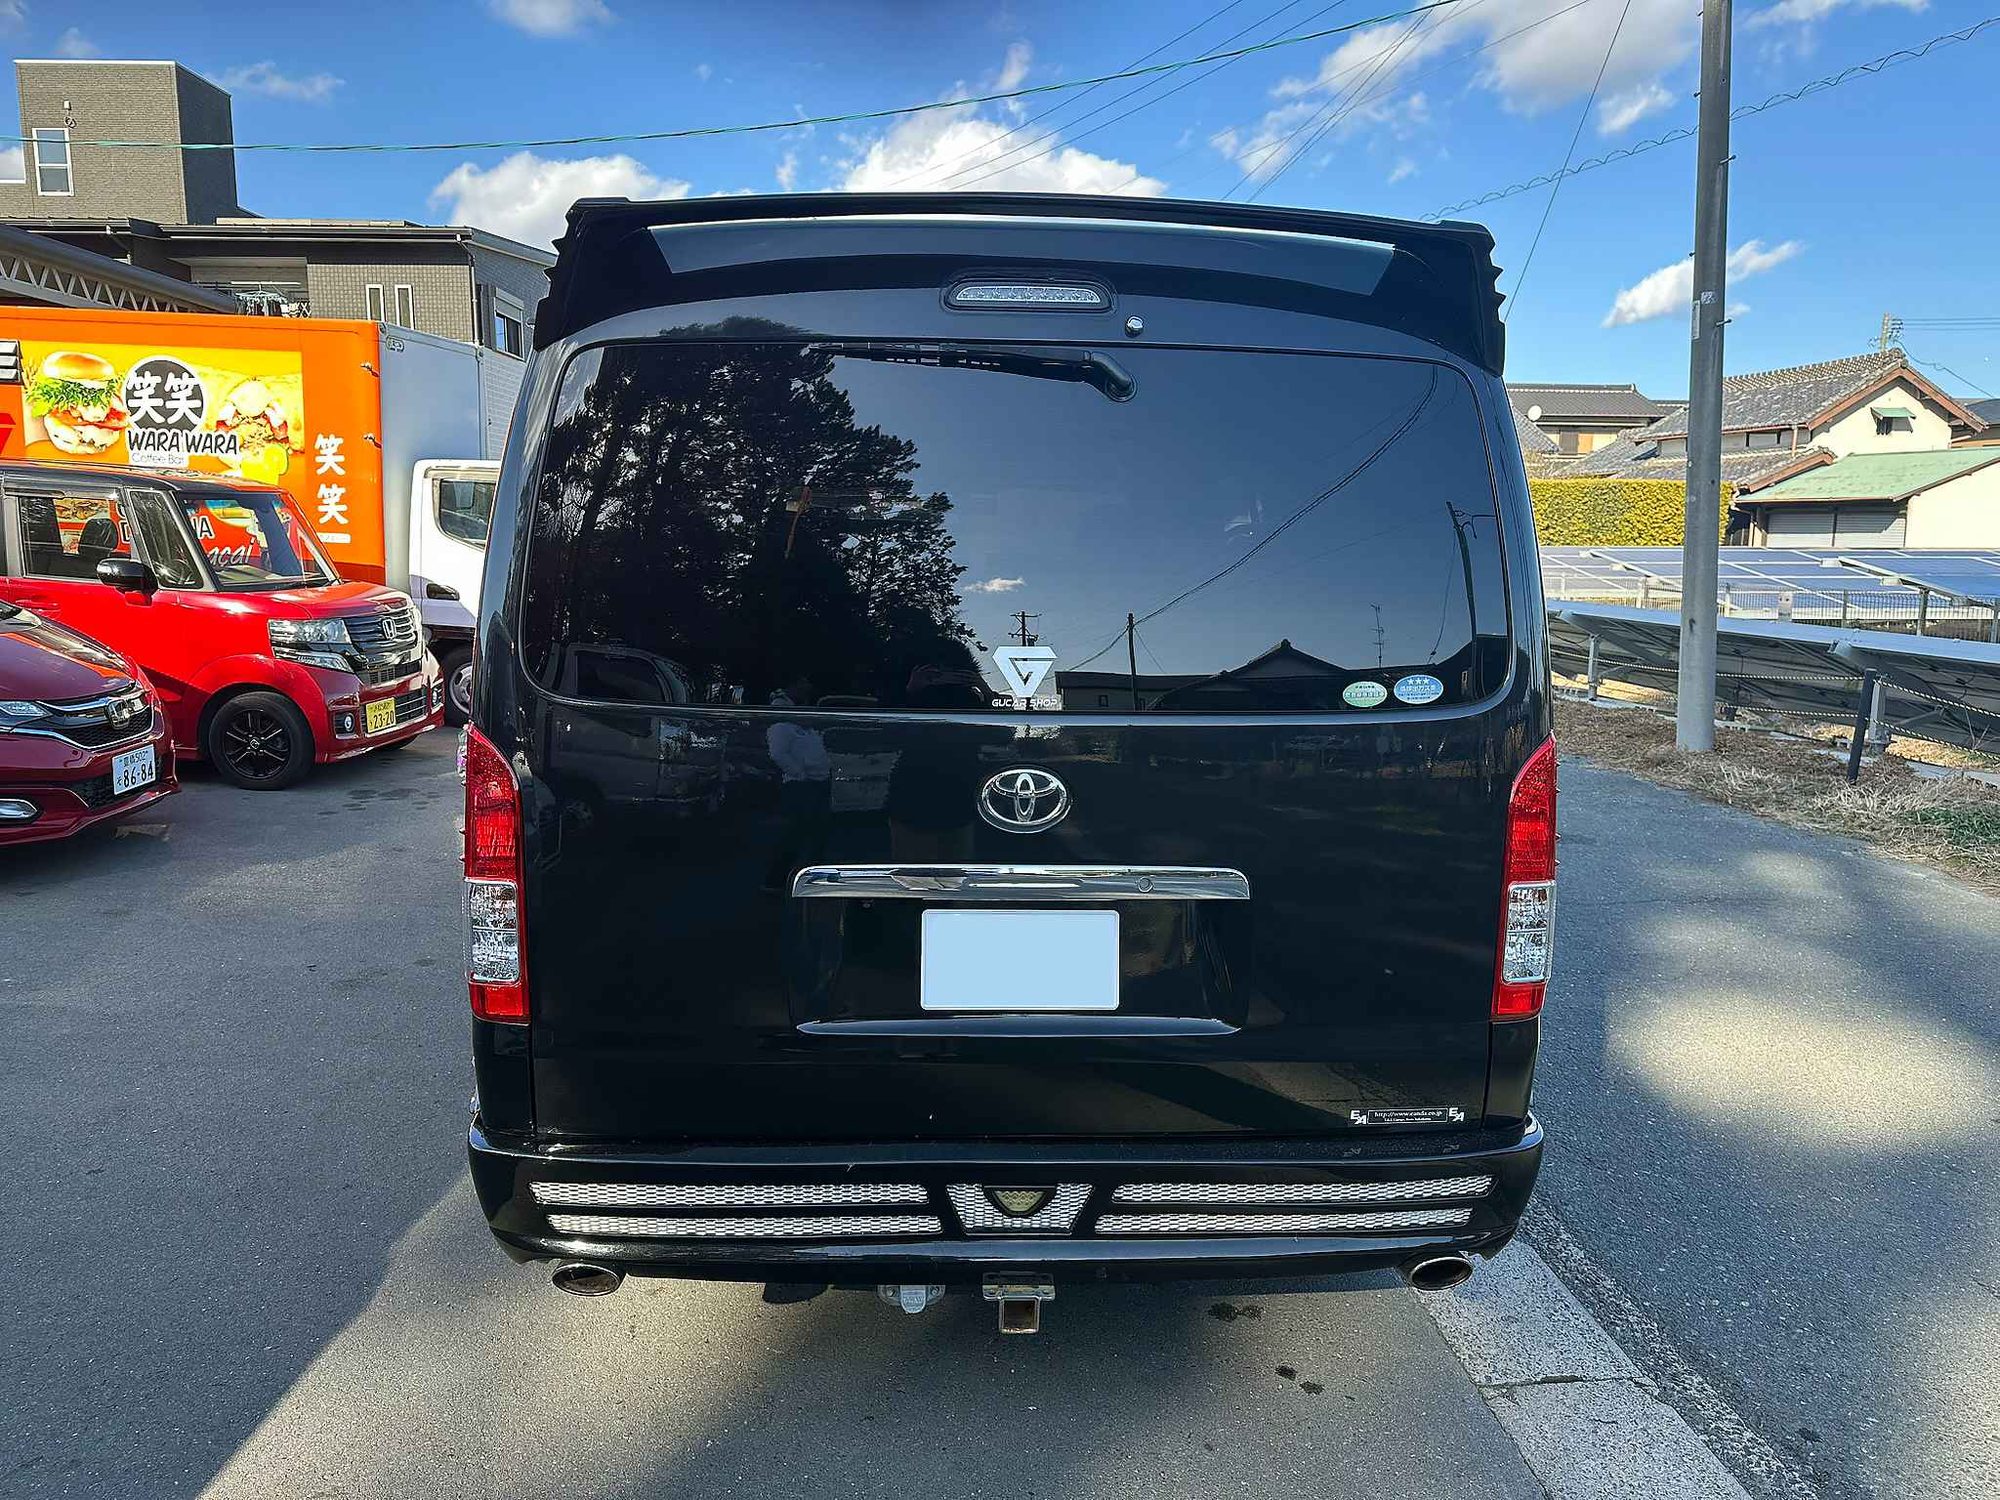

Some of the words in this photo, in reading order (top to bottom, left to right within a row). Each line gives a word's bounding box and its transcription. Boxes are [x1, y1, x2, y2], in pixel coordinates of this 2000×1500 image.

[127, 370, 202, 425] 笑笑
[127, 430, 180, 452] WARA
[185, 432, 238, 454] WARA
[314, 433, 349, 525] 笑笑
[1029, 698, 1058, 708] SHOP
[123, 760, 154, 788] 86-84
